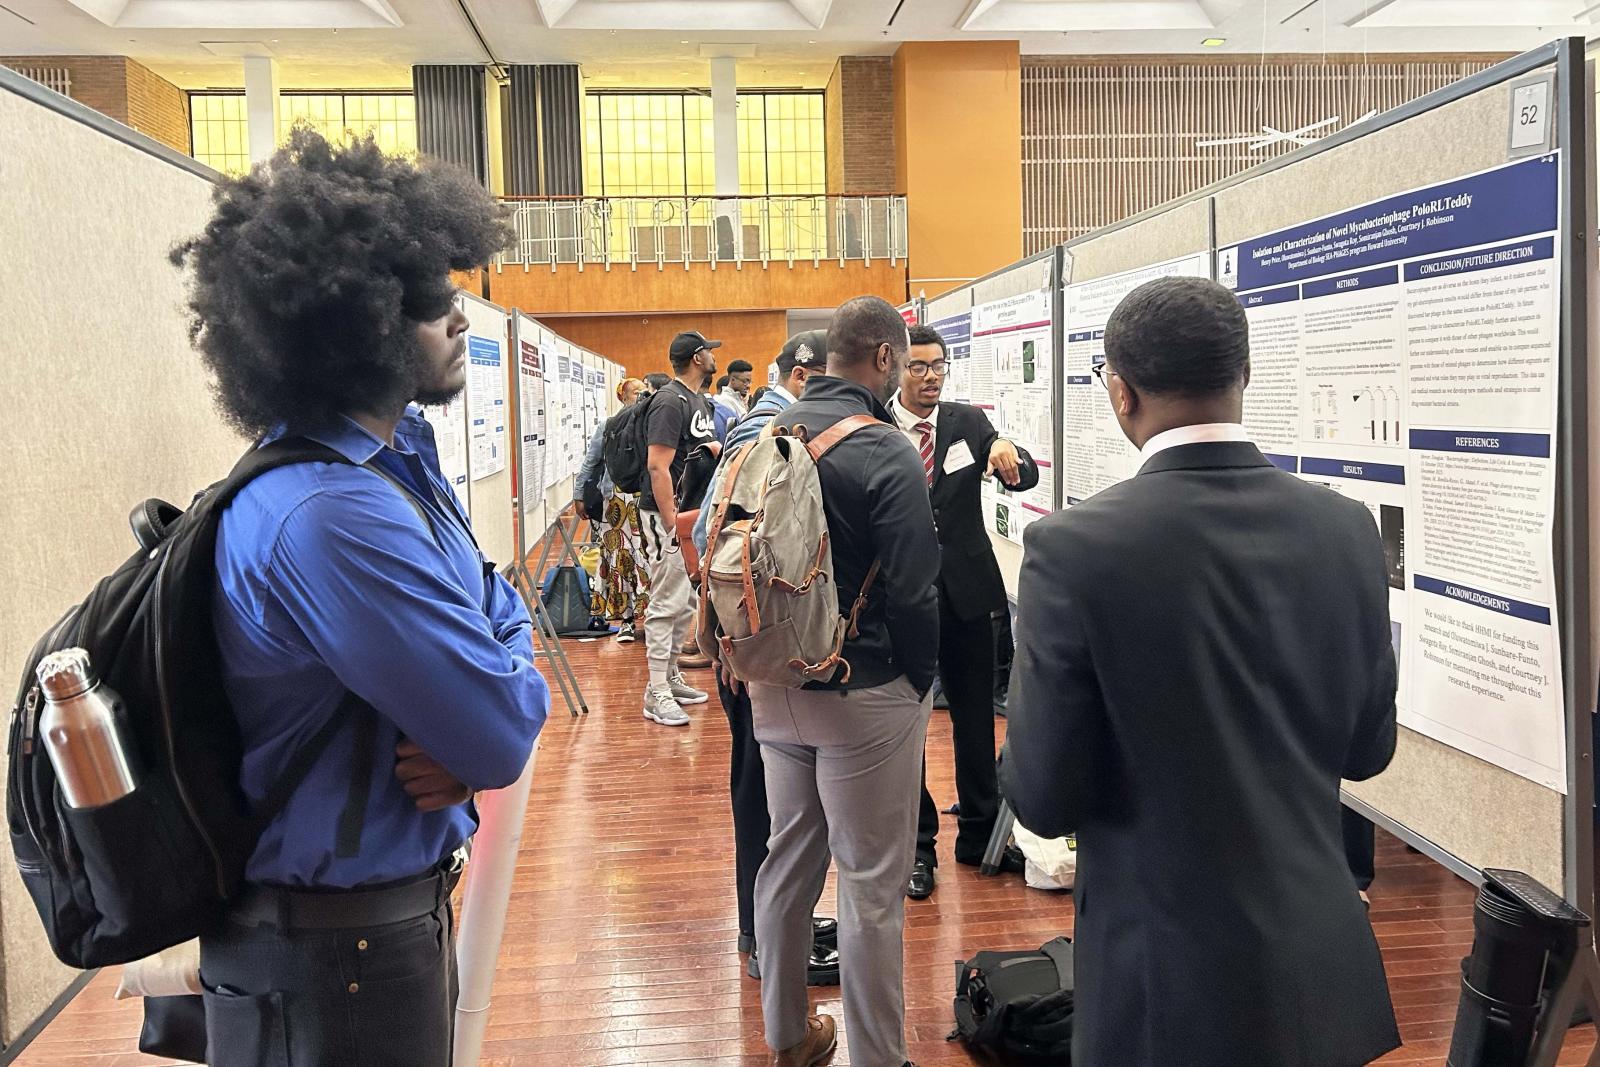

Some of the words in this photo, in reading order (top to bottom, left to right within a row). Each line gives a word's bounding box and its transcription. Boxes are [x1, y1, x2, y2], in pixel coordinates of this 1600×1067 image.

[1520, 105, 1538, 126] 52
[1253, 246, 1272, 259] Isolation
[1272, 241, 1283, 254] and
[1283, 232, 1325, 251] Characterization
[1325, 228, 1333, 240] of
[1332, 225, 1348, 239] Novel
[1348, 210, 1411, 236] Mycobacteriophage
[1271, 256, 1281, 264] Price,
[1397, 222, 1420, 233] Courtney
[1420, 220, 1425, 230] J.
[1426, 214, 1454, 227] Robinson
[1288, 259, 1308, 270] Department
[1349, 246, 1367, 257] program
[1367, 239, 1384, 251] Howard
[1384, 235, 1408, 248] University
[1420, 255, 1494, 275] CONCLUSION/FUTURE
[1494, 245, 1534, 262] DIRECTION
[1336, 277, 1359, 289] METHODS
[1455, 436, 1500, 449] REFERENCES
[1343, 464, 1363, 475] RESULTS
[1445, 585, 1510, 612] ACKNOWLEDGEMENTS
[1475, 624, 1491, 638] HHMI
[1492, 630, 1501, 640] for
[1502, 632, 1526, 650] funding
[1526, 640, 1539, 651] this
[1423, 649, 1444, 665] Robinson
[1453, 662, 1480, 680] mentoring
[1480, 673, 1490, 682] me
[1490, 675, 1527, 694] throughout
[1527, 687, 1541, 699] this
[1477, 655, 1497, 671] Ghosh,
[1498, 664, 1510, 673] and
[1511, 666, 1543, 685] Courtney
[1543, 675, 1549, 686] J.
[1447, 675, 1471, 690] research
[1471, 684, 1505, 702] experience.
